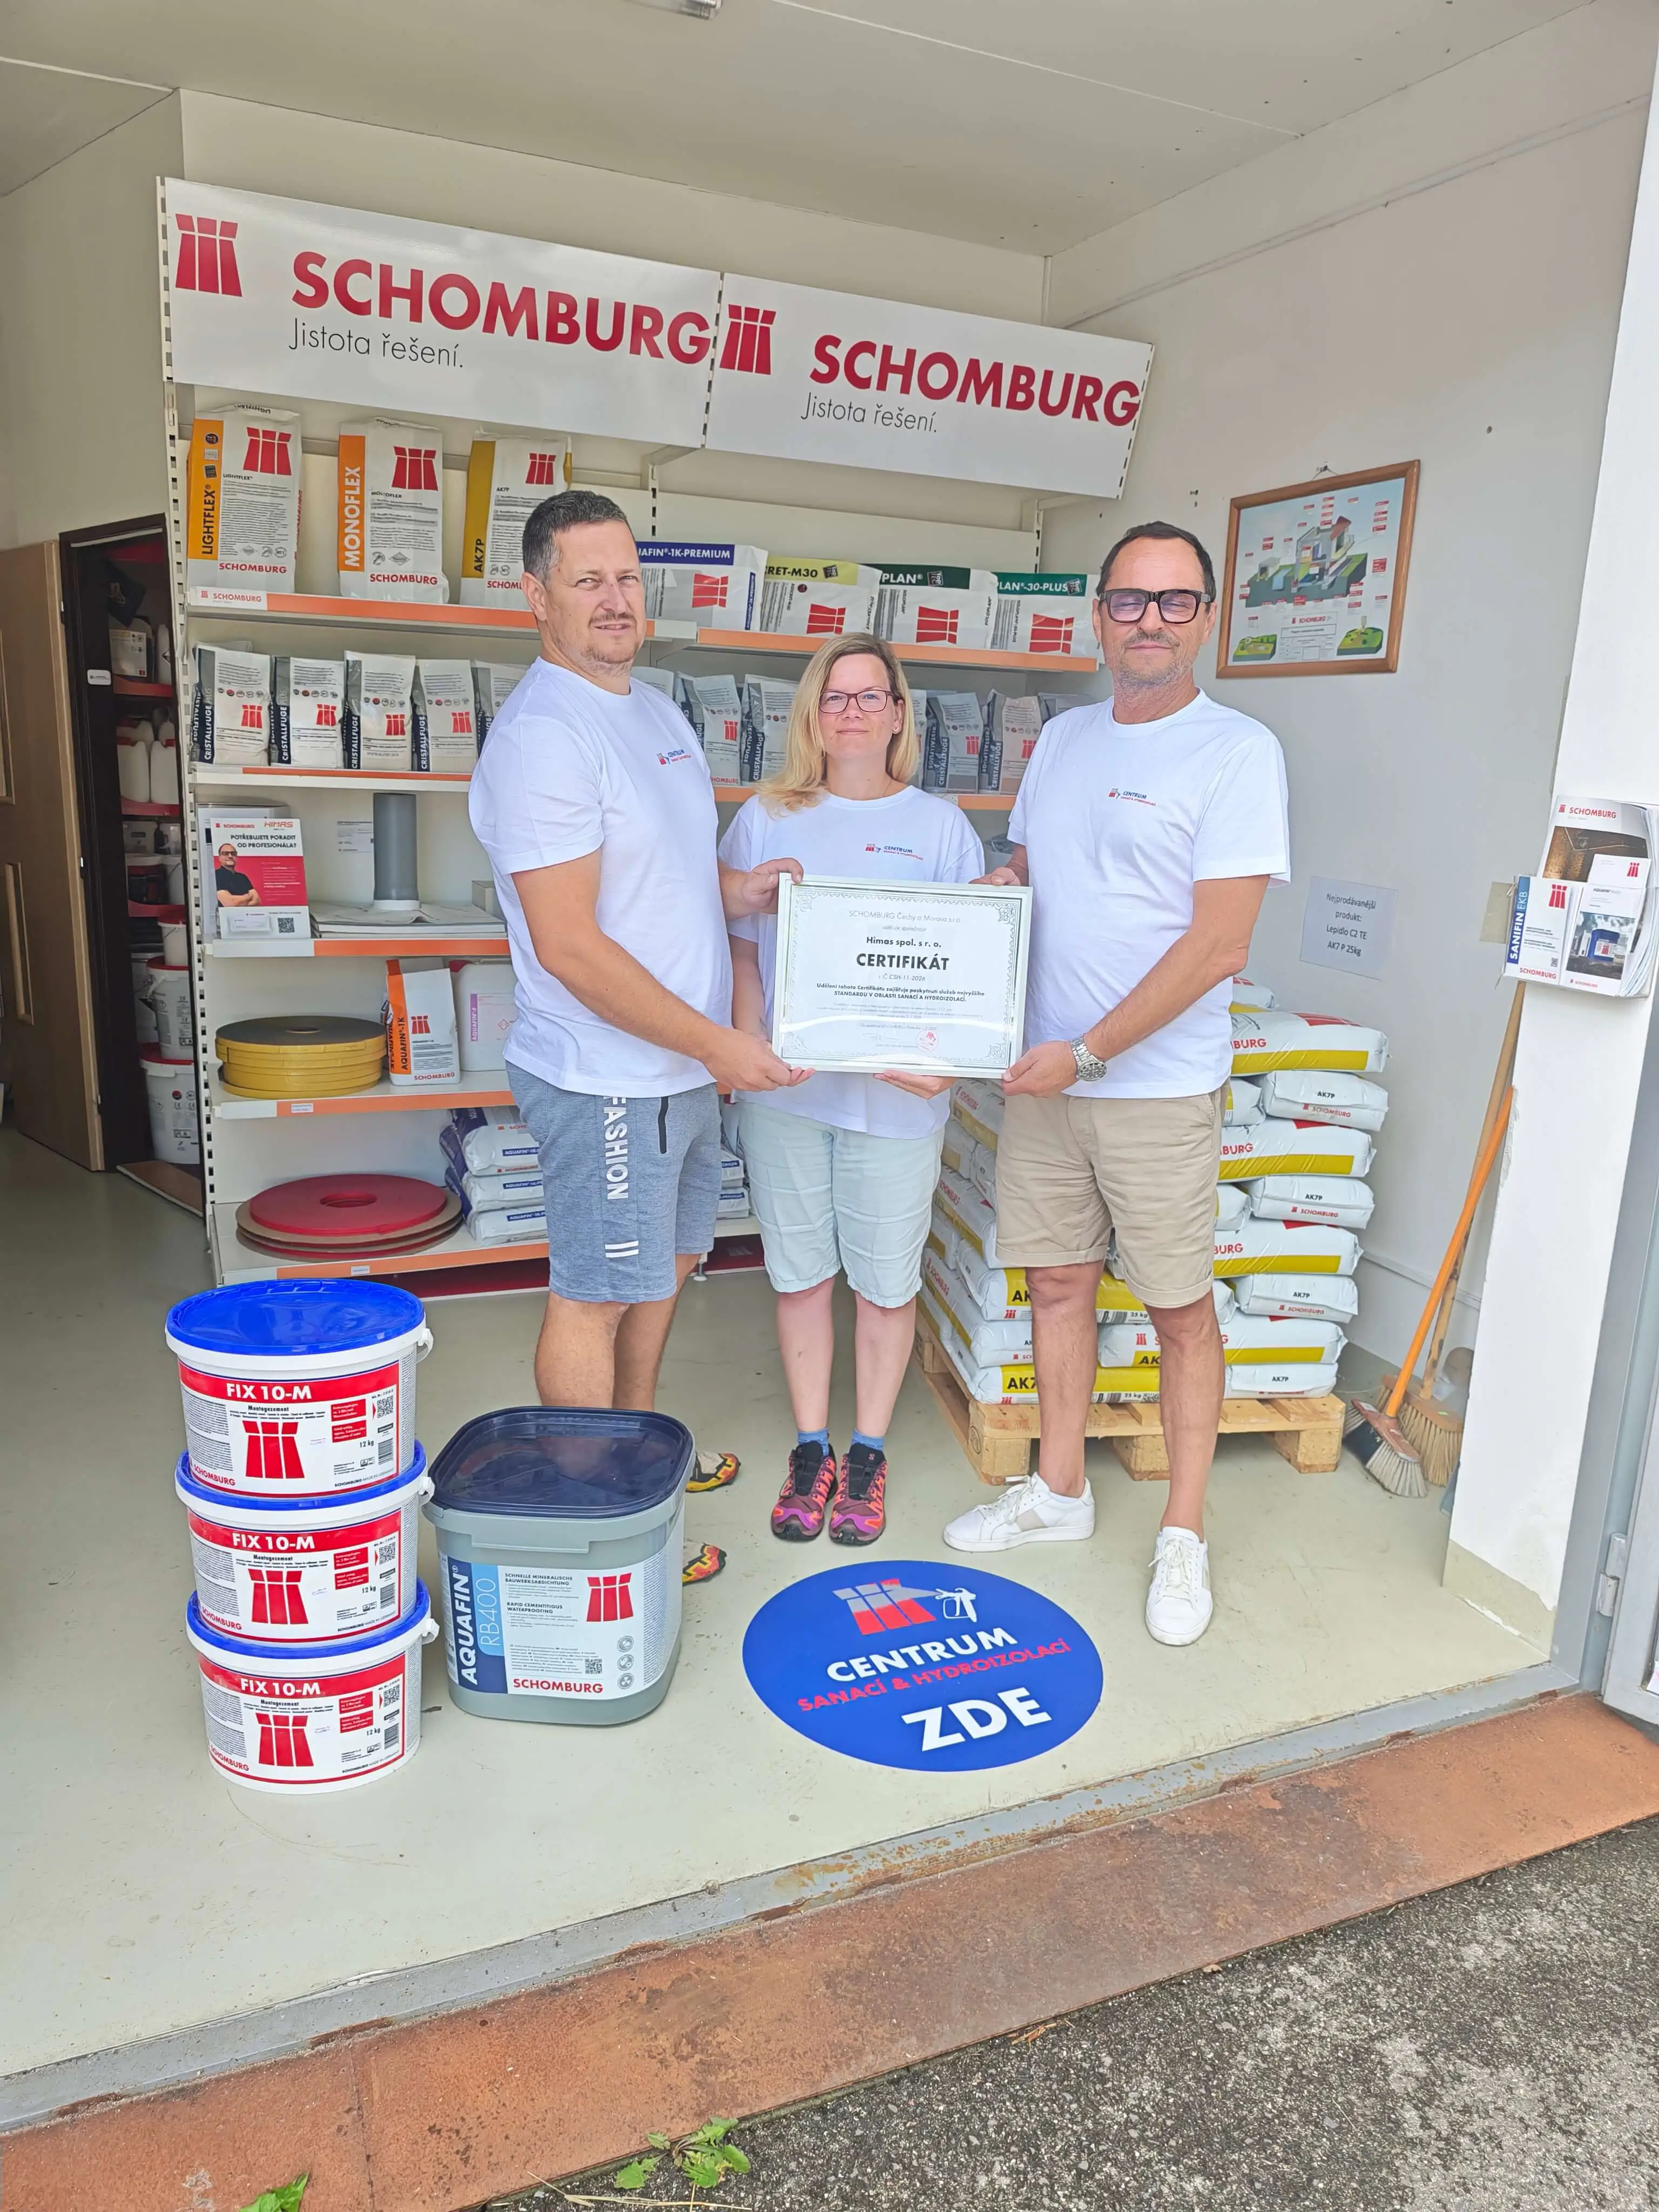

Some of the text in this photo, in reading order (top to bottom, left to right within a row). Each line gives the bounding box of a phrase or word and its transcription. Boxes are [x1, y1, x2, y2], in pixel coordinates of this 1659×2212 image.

[291, 251, 710, 365] SCHOMBURG
[289, 318, 463, 369] Jistota řešení.
[810, 334, 1140, 427] SCHOMBURG
[801, 392, 938, 433] Jistota řešení.
[201, 484, 217, 555] LIGHTFLEX®
[345, 466, 361, 567] MONOFLEX
[474, 538, 484, 572] AK7P
[219, 563, 287, 574] SCHOMBURG
[369, 574, 438, 585] SCHOMBURG
[487, 581, 522, 590] SCHOM
[213, 592, 262, 603] SCHOMBURG
[753, 733, 764, 781] CRISTALLFUGE
[1569, 807, 1616, 819] SCHOMBURG
[1516, 891, 1528, 911] EKB
[849, 911, 895, 919] SCHOMBURG
[897, 912, 916, 921] Čechy
[1336, 911, 1362, 922] produkt:
[1326, 925, 1367, 940] Lepidlo C2 TE
[1509, 912, 1525, 960] SANIFIN
[895, 938, 916, 947] spol.
[1327, 941, 1340, 950] AK7
[1346, 945, 1361, 957] 25kg
[857, 953, 949, 970] CERTIFIKÁT
[1520, 967, 1556, 979] SCHOMBURG
[397, 1016, 408, 1070] AQUAFIN®-1K
[414, 1072, 455, 1081] SCHOMBURG
[1317, 1091, 1336, 1099] AK7P
[1312, 1106, 1351, 1118] SCHOMBURG
[1300, 1209, 1339, 1218] SCHOMBURG
[1287, 1306, 1325, 1315] SCHOMBURG
[226, 1383, 312, 1400] FIX 10-M
[194, 1465, 235, 1487] SCHOMBURG
[335, 1478, 362, 1487] SCHOMBURG
[232, 1533, 315, 1550] FIX 10-M
[202, 1607, 242, 1630] SCHOMBURG
[476, 1577, 501, 1645] RB400
[452, 1564, 477, 1685] AQUAFIN®
[827, 1627, 1018, 1682] CENTRUM
[797, 1637, 1071, 1711] SANACÍ & HYDROIZOLACÍ
[240, 1678, 321, 1696] FIX 10-M
[514, 1678, 603, 1694] SCHOMBURG
[260, 1699, 299, 1707] Montagezement
[901, 1687, 1053, 1752] ZDE
[211, 1745, 249, 1771] SCHOMBURG
